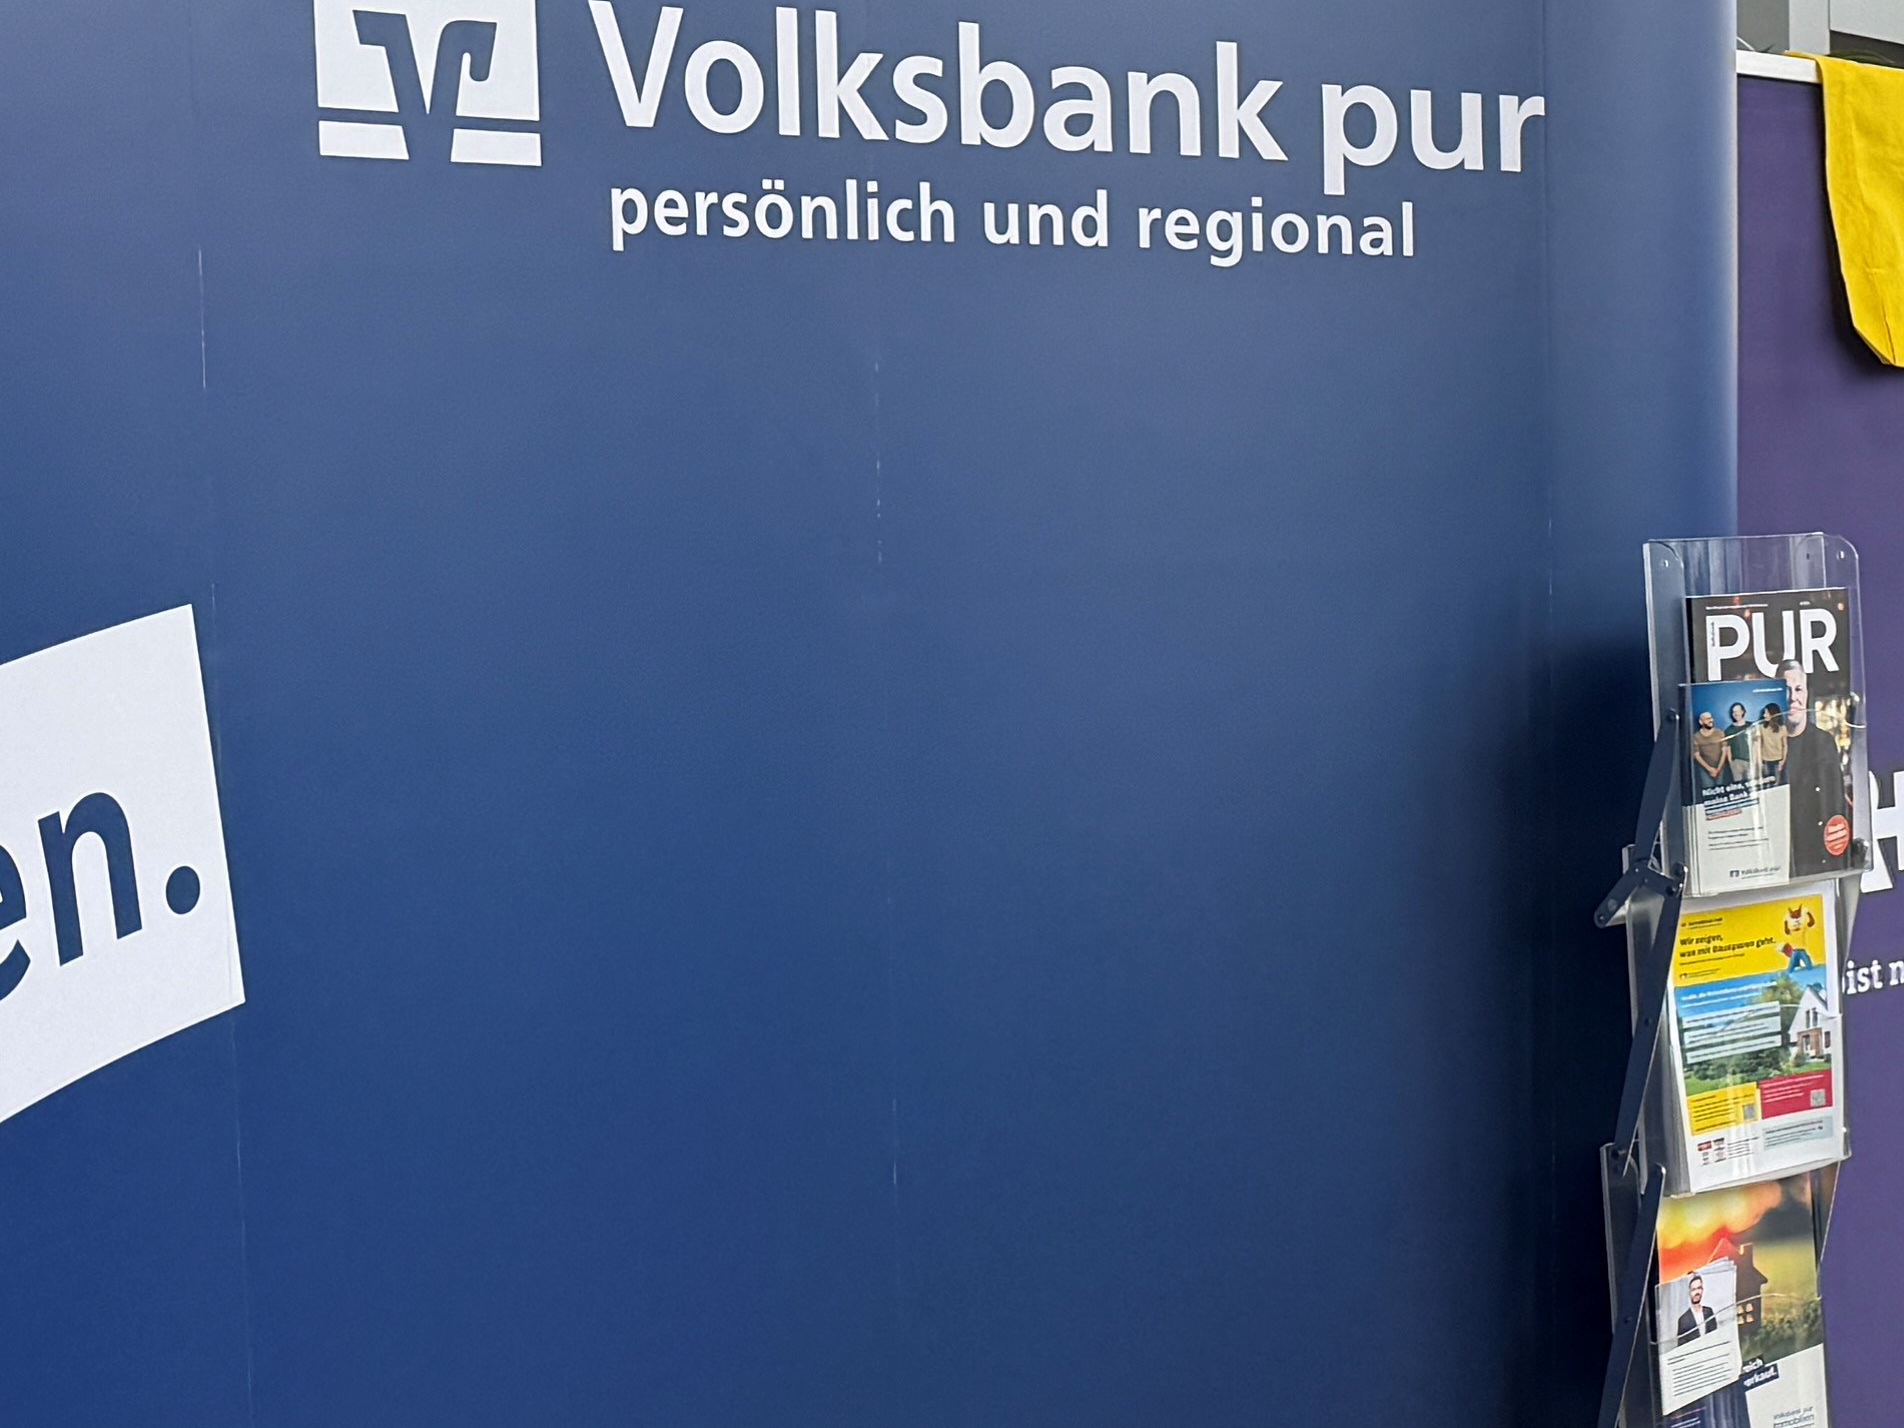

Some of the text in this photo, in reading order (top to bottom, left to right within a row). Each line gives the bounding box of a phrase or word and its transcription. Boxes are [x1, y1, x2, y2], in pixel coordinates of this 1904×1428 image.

[1322, 84, 1547, 195] pur
[609, 177, 1418, 269] persönlich und regional
[1705, 608, 1840, 682] PUR
[1842, 959, 1883, 995] ist
